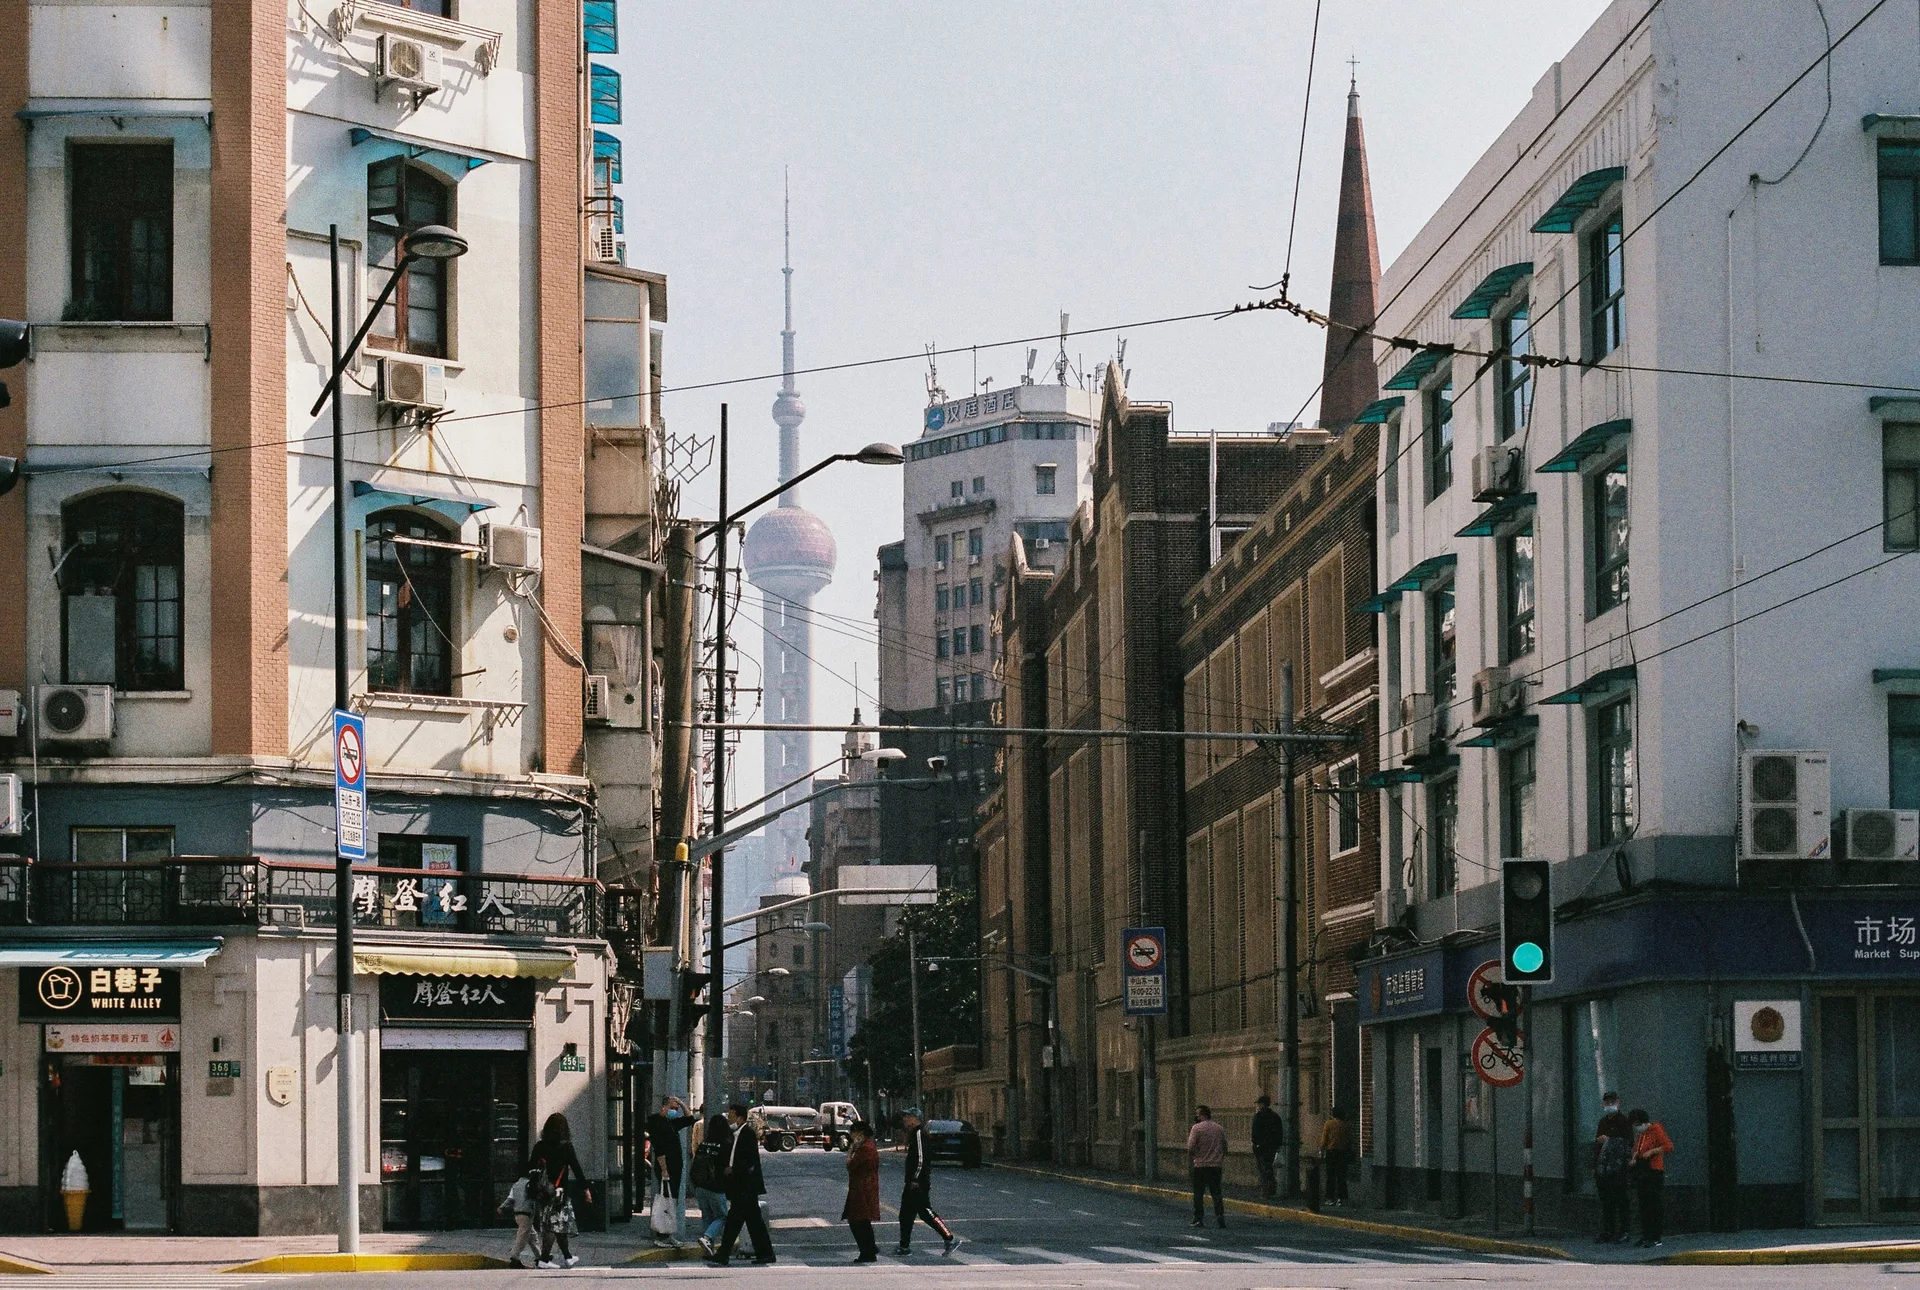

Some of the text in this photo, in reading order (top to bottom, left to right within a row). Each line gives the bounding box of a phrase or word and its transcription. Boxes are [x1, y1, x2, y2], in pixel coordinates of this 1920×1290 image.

[946, 390, 1015, 424] 汉庭酒店
[352, 876, 514, 915] 摩登红人
[1854, 916, 1916, 946] 市场
[1854, 950, 1890, 959] Market
[90, 968, 162, 993] 白巷子
[1386, 968, 1424, 994] 市场监督管理
[91, 998, 162, 1009] WHITE ALLEY
[413, 980, 506, 1007] 摩登红人
[211, 1062, 229, 1072] 368
[562, 1057, 577, 1066] 256
